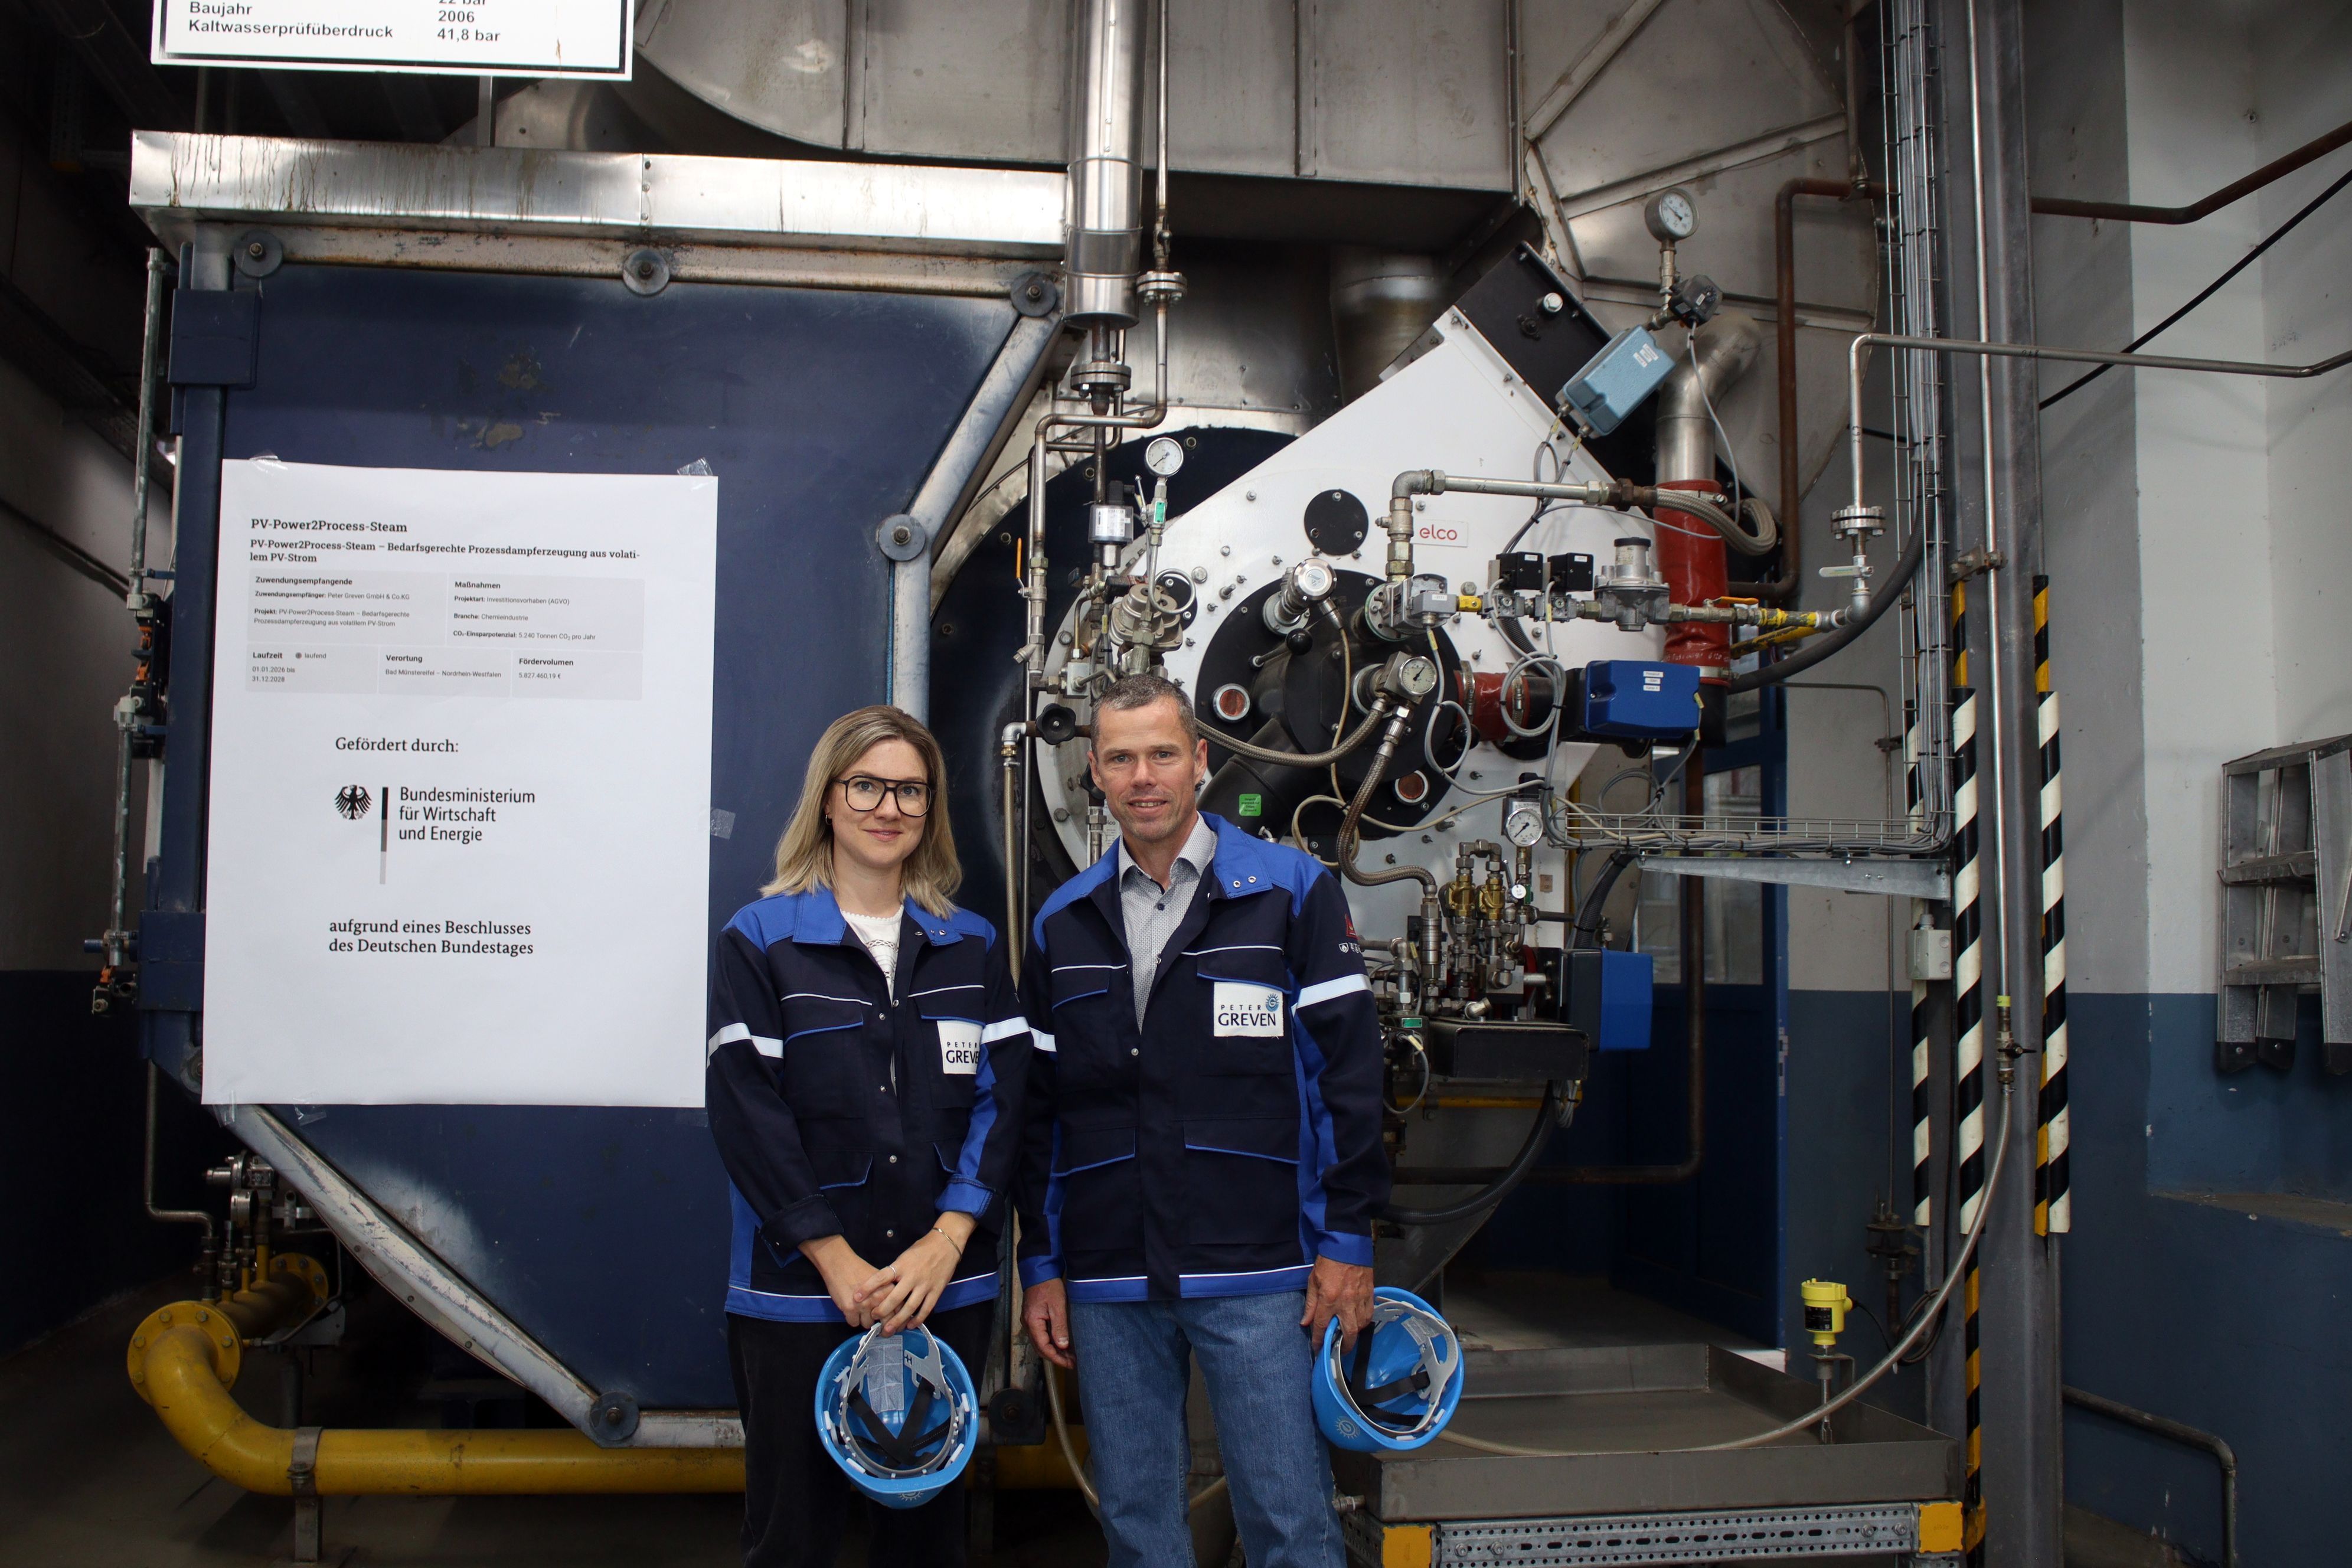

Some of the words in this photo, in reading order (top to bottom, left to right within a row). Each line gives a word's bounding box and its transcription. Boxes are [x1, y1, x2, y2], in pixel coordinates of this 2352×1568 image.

[190, 1, 252, 17] Baujahr
[438, 10, 475, 22] 2006
[189, 19, 393, 37] Kaltwasserprüfüberdruck
[437, 28, 469, 42] 41,8
[475, 30, 500, 41] bar
[251, 519, 407, 532] PV-Power2Process-Steam
[1420, 524, 1457, 540] elco
[250, 540, 375, 550] PV-Power2Process-Steam
[388, 543, 465, 553] Bedarfsgerechte
[469, 545, 587, 558] Prozessdampferzeugung
[609, 550, 640, 558] volati-
[250, 553, 267, 561] lem
[271, 553, 317, 562] PV-Strom
[256, 577, 352, 586] Zuwendungsempfangende
[386, 655, 423, 664] Verortung
[335, 737, 407, 752] Gefördert
[411, 739, 459, 752] durch:
[400, 787, 535, 803] Bundesministerium
[399, 806, 419, 821] für
[423, 807, 496, 822] Wirtschaft
[399, 826, 425, 840] und
[430, 827, 482, 844] Energie
[329, 919, 398, 935] aufgrund
[403, 919, 440, 933] eines
[445, 920, 531, 935] Beschlusses
[329, 939, 353, 952] des
[358, 940, 437, 953] Deutschen
[442, 940, 533, 956] Bundestages
[1218, 1012, 1276, 1026] GREVEN
[946, 1050, 979, 1064] GREVE
